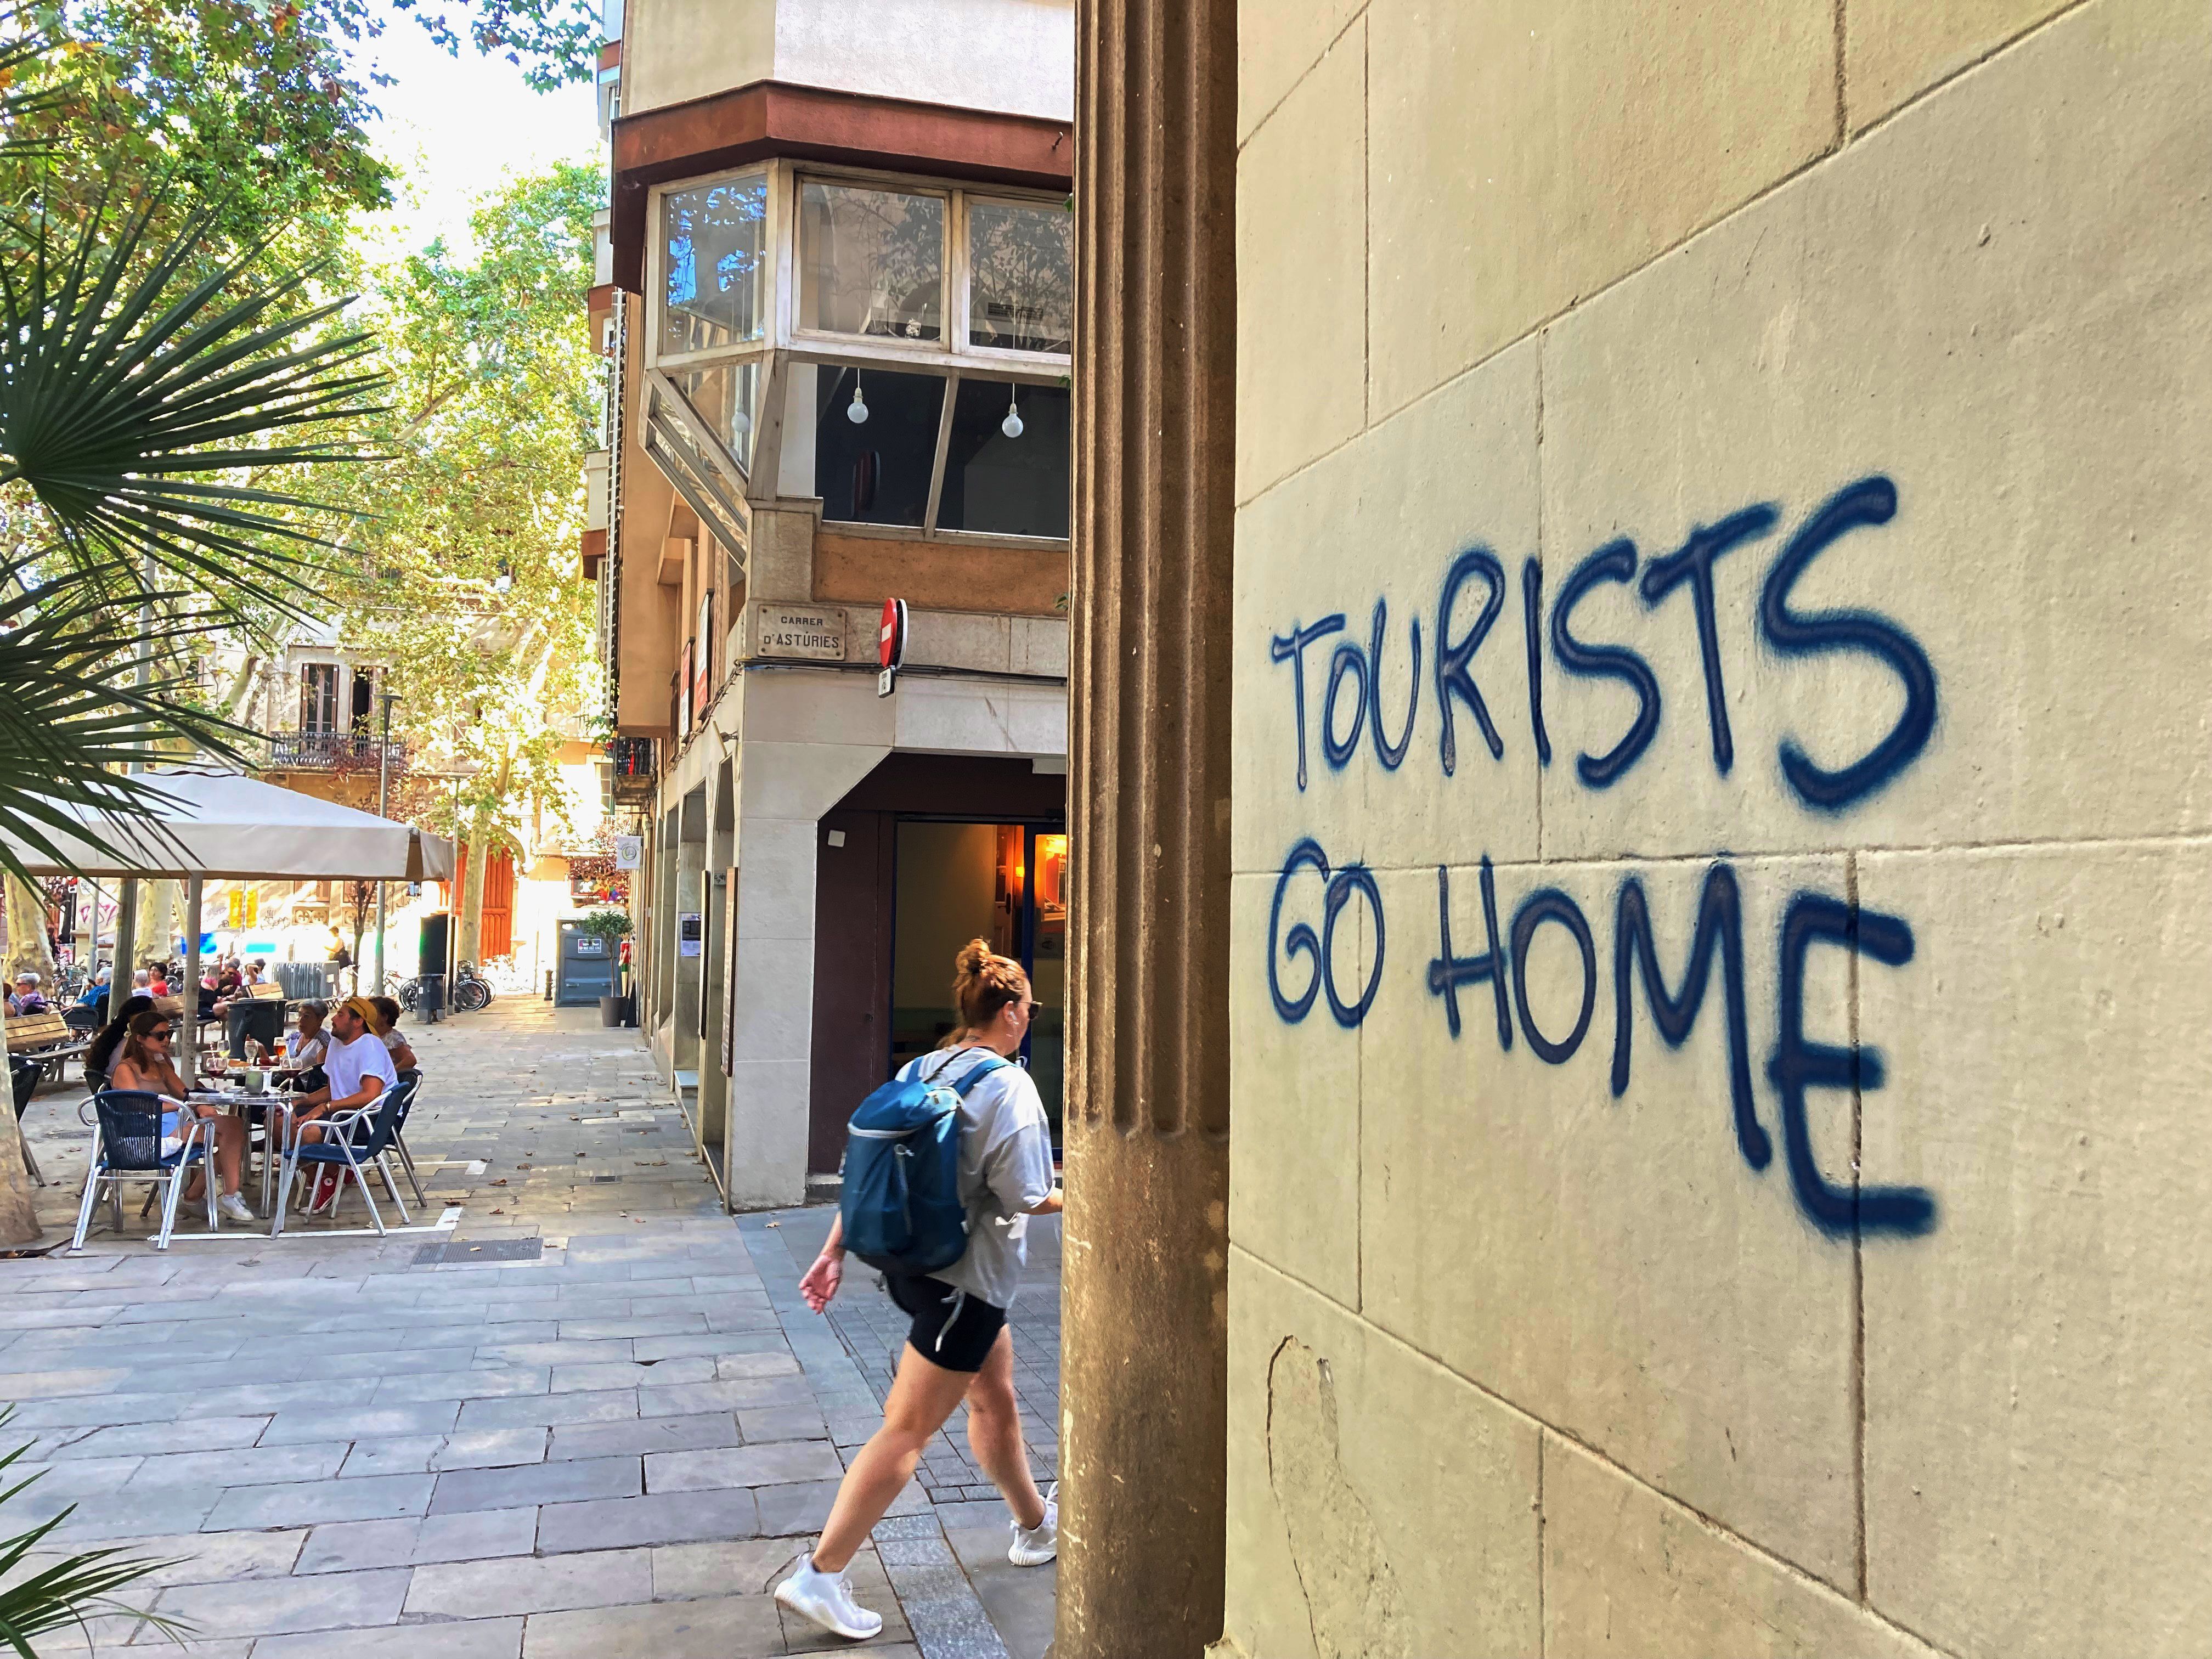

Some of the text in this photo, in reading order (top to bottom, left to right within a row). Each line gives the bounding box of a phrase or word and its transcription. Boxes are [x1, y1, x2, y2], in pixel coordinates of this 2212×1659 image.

[764, 631, 839, 648] D'ASTÚRIES
[781, 616, 823, 625] CARRER
[1268, 474, 1937, 814] TOURISTS
[1267, 837, 1938, 1240] GO HOME
